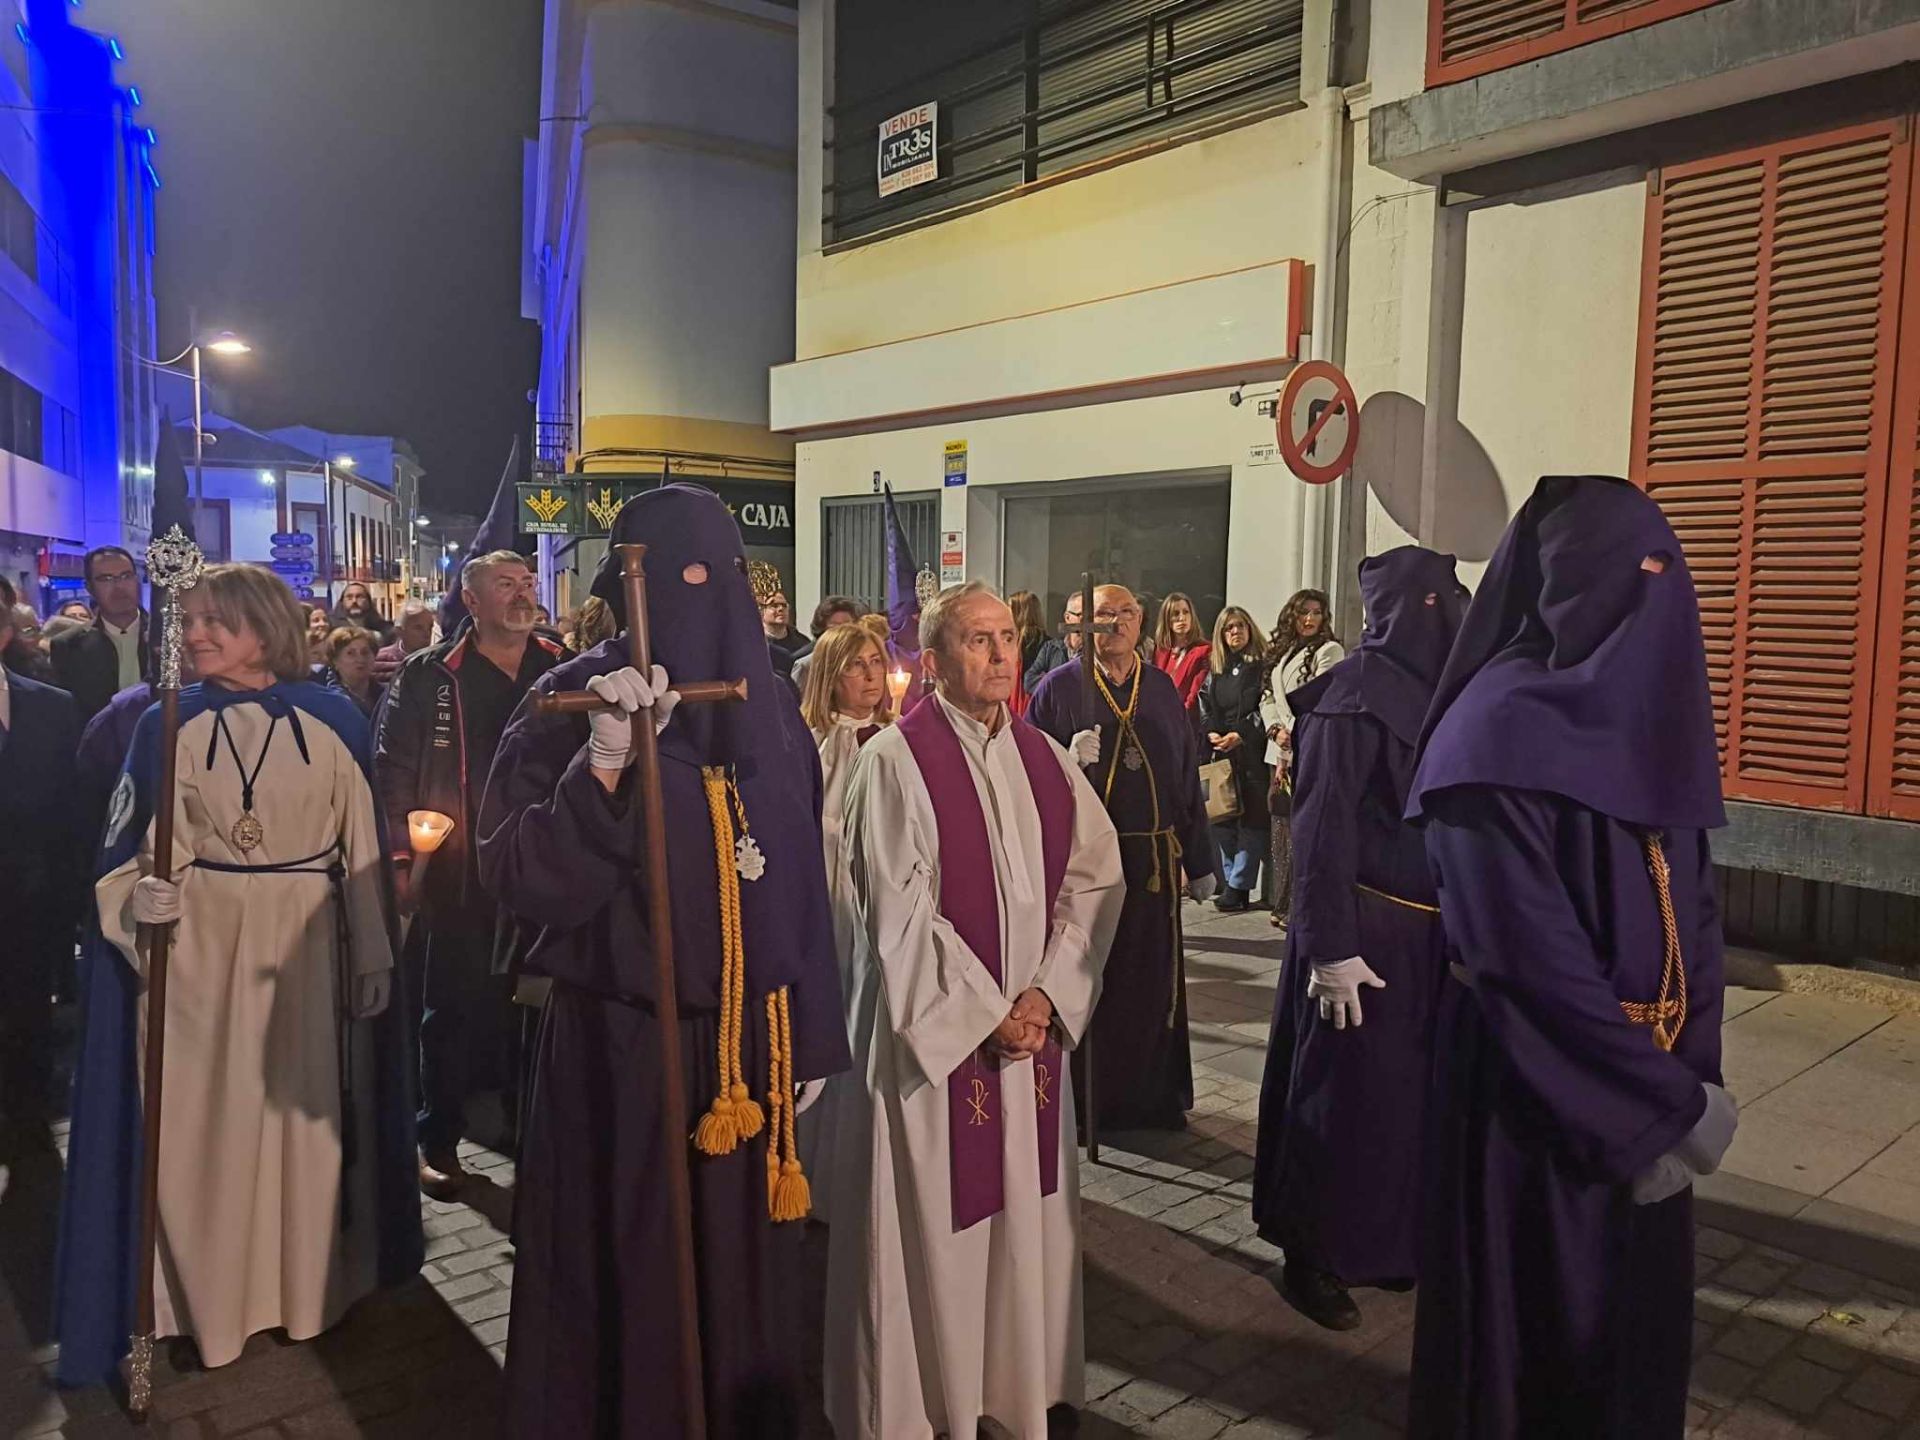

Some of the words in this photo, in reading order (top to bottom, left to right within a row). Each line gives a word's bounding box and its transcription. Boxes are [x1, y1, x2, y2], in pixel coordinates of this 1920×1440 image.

[884, 107, 928, 137] VENDE
[889, 128, 931, 160] TR3S
[741, 503, 791, 530] CAJA
